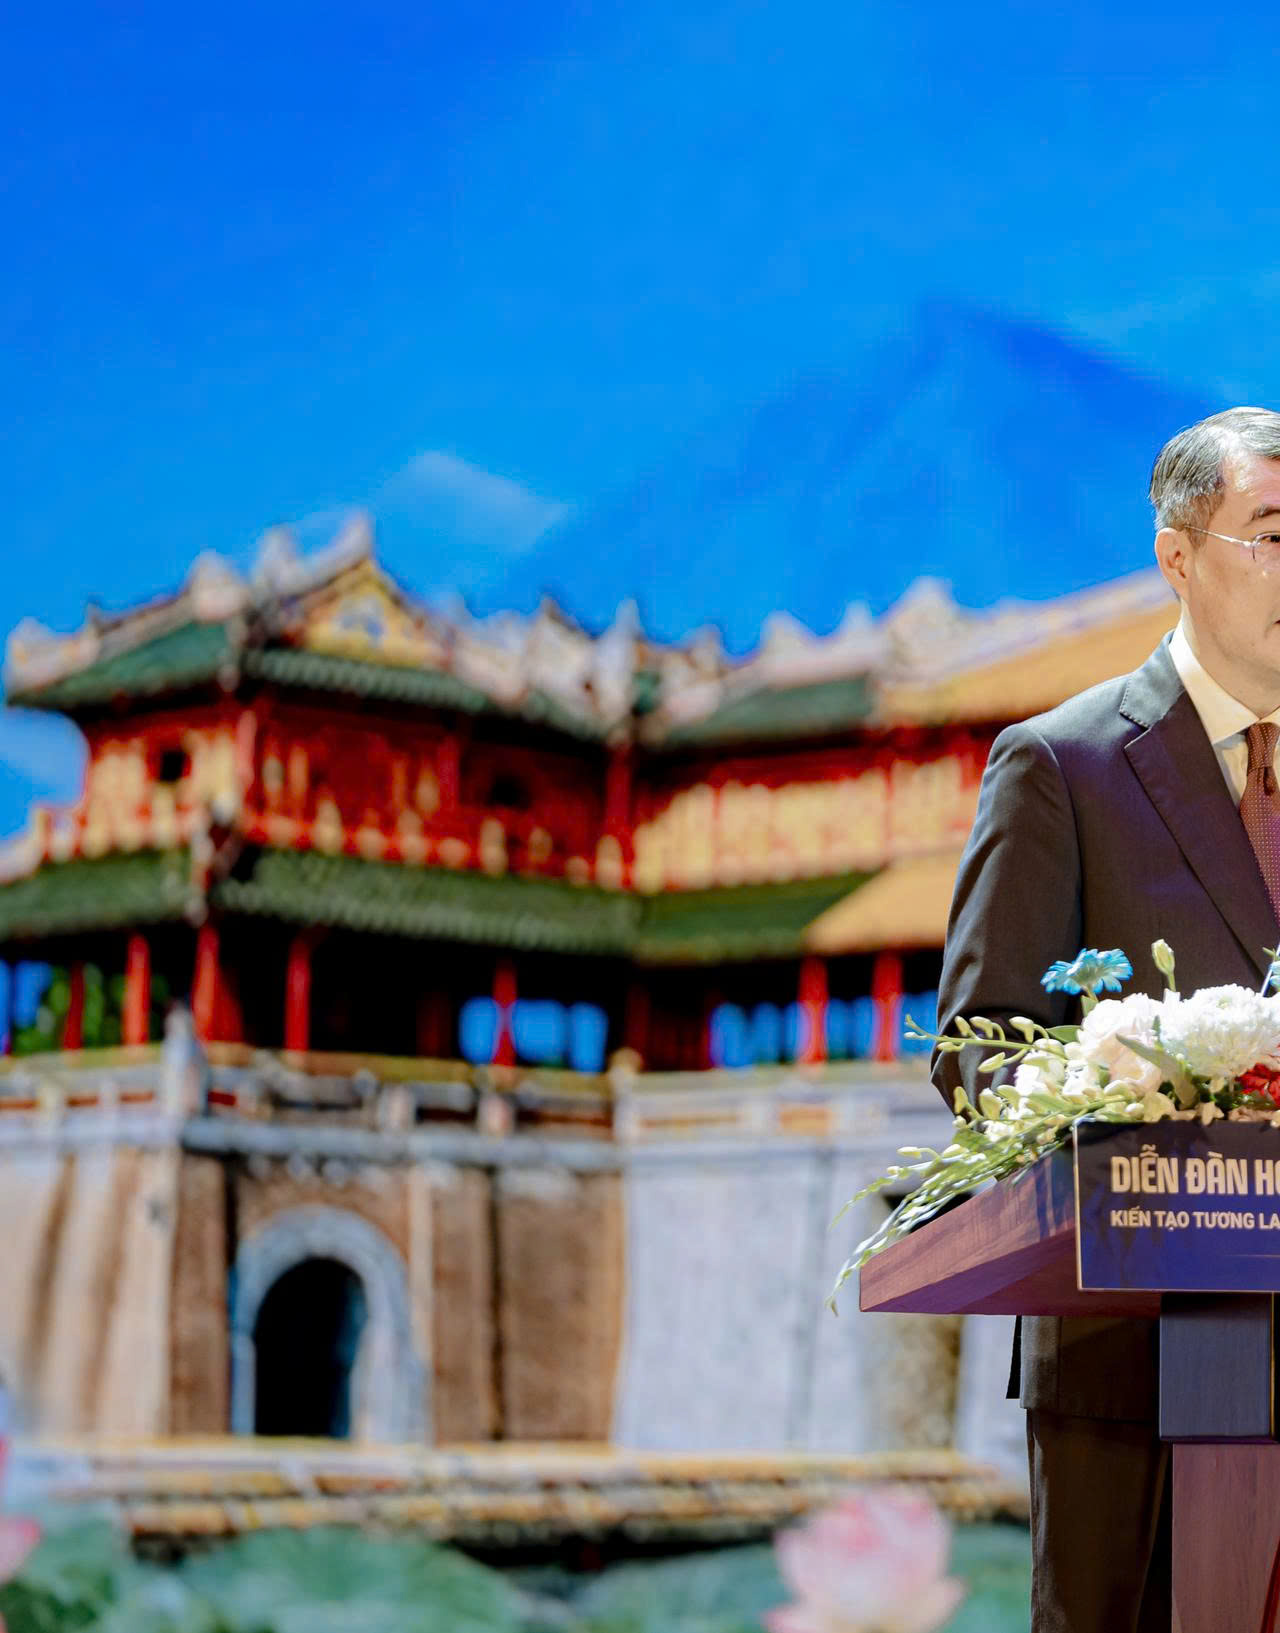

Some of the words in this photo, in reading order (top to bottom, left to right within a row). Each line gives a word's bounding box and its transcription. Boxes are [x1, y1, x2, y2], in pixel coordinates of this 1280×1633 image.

[1111, 1144, 1178, 1193] DIỄN
[1185, 1151, 1248, 1196] ĐÀN
[1110, 1205, 1151, 1228] KIẾN
[1154, 1212, 1189, 1231] TẠO
[1193, 1213, 1255, 1229] TƯƠNG
